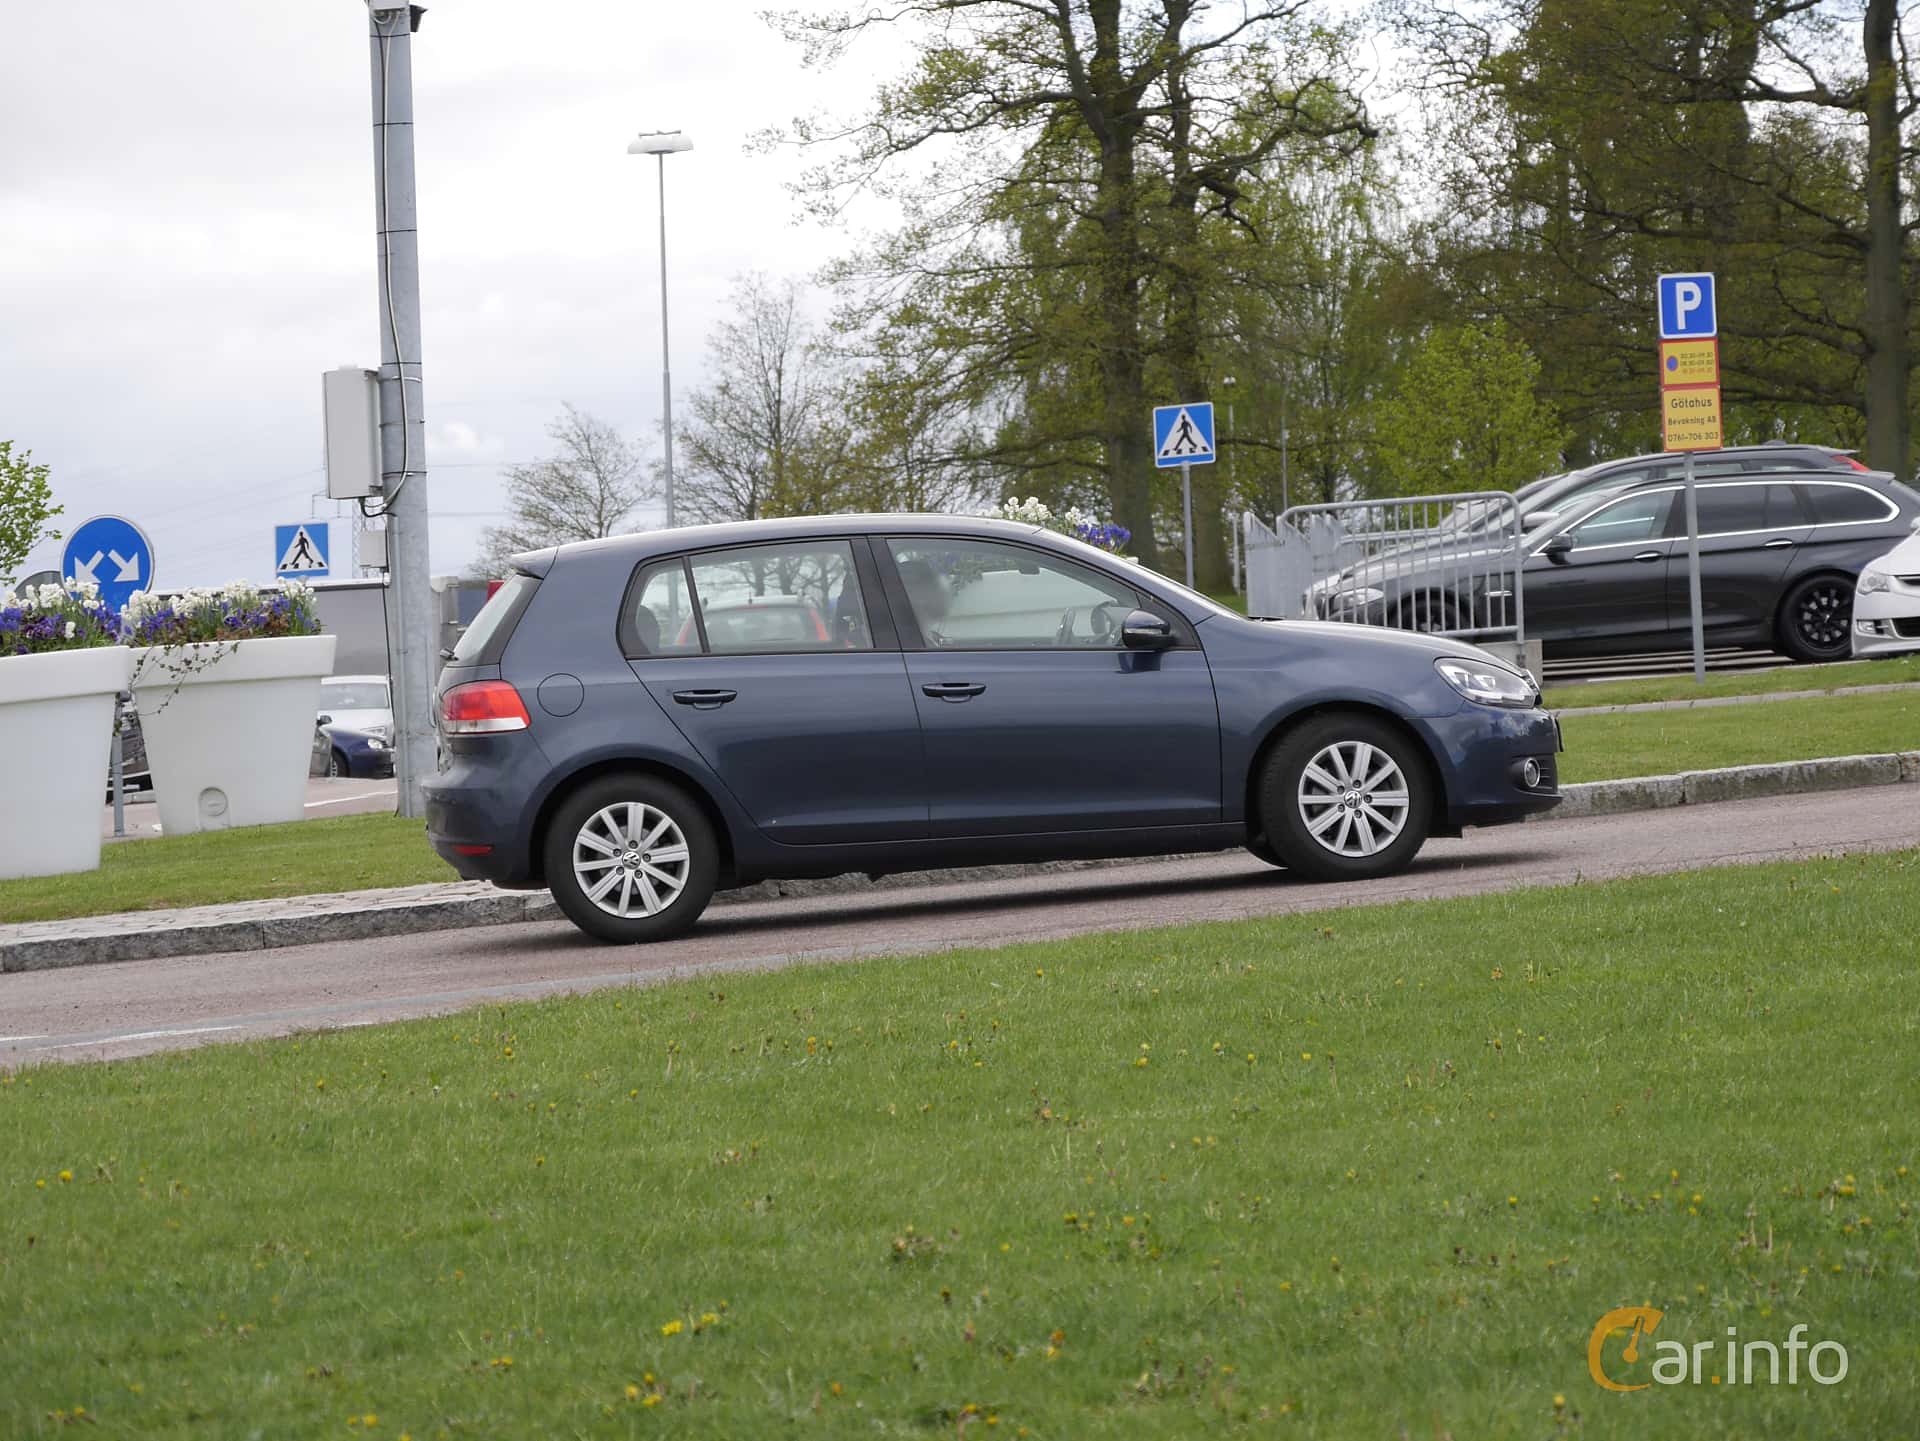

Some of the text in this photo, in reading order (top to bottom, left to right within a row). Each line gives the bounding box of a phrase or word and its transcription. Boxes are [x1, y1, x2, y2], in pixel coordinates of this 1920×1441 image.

[1675, 281, 1702, 330] P
[1671, 397, 1713, 409] Götahus
[1668, 416, 1705, 426] Bevakning
